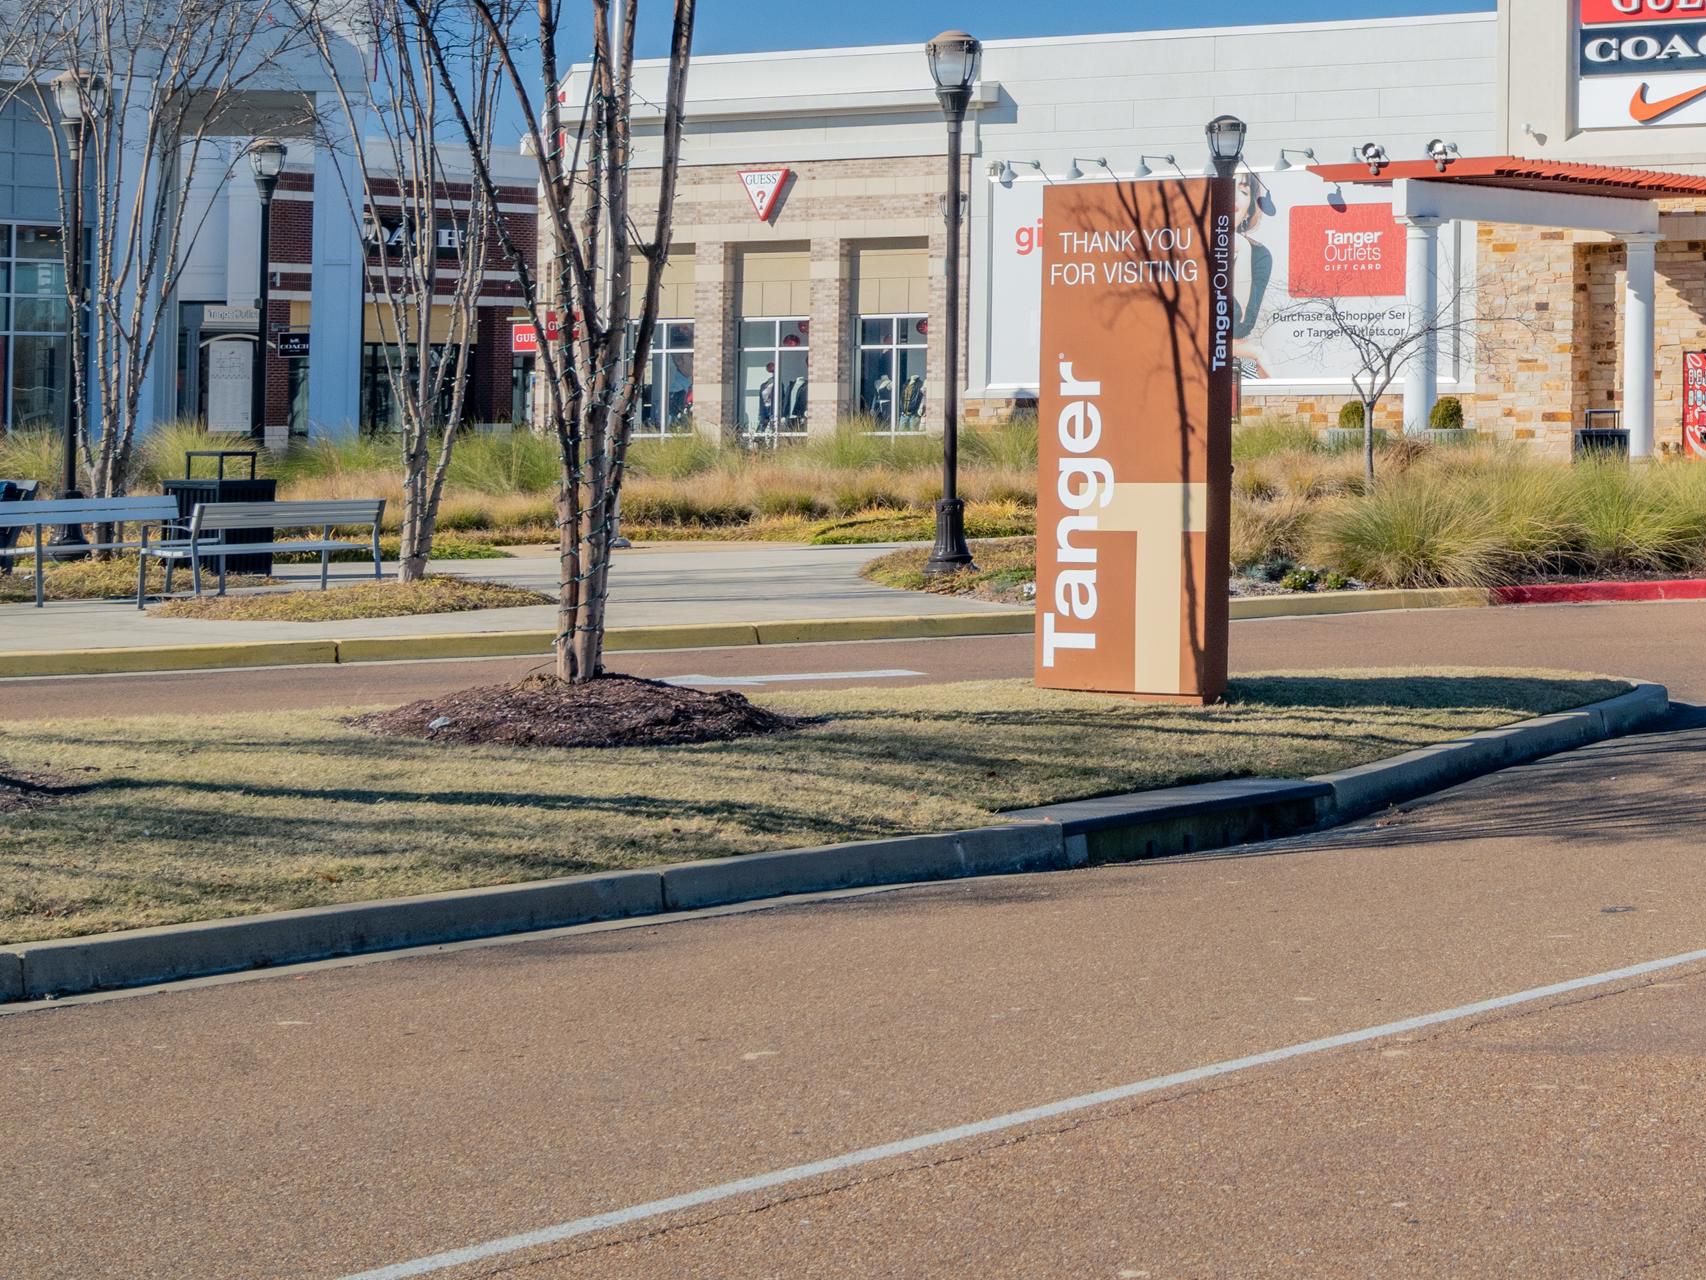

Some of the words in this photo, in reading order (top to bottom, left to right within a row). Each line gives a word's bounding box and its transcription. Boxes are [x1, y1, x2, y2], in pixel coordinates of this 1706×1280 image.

[745, 174, 777, 185] GUESS
[1015, 218, 1043, 255] gi
[1059, 230, 1136, 254] THANK
[1143, 227, 1192, 251] YOU
[1325, 229, 1383, 248] Tanger
[1324, 243, 1382, 262] Outlets
[1050, 263, 1095, 285] FOR
[1103, 259, 1198, 284] VISITING
[1324, 264, 1349, 272] GIFT
[1352, 263, 1382, 271] CARD
[1212, 214, 1231, 372] TangerOutlets
[1272, 312, 1322, 322] Purchase
[1340, 311, 1385, 322] Shopper
[1388, 310, 1406, 320] Ser
[1293, 329, 1304, 338] or
[279, 342, 310, 351] COACH
[1042, 358, 1115, 668] Tanger
